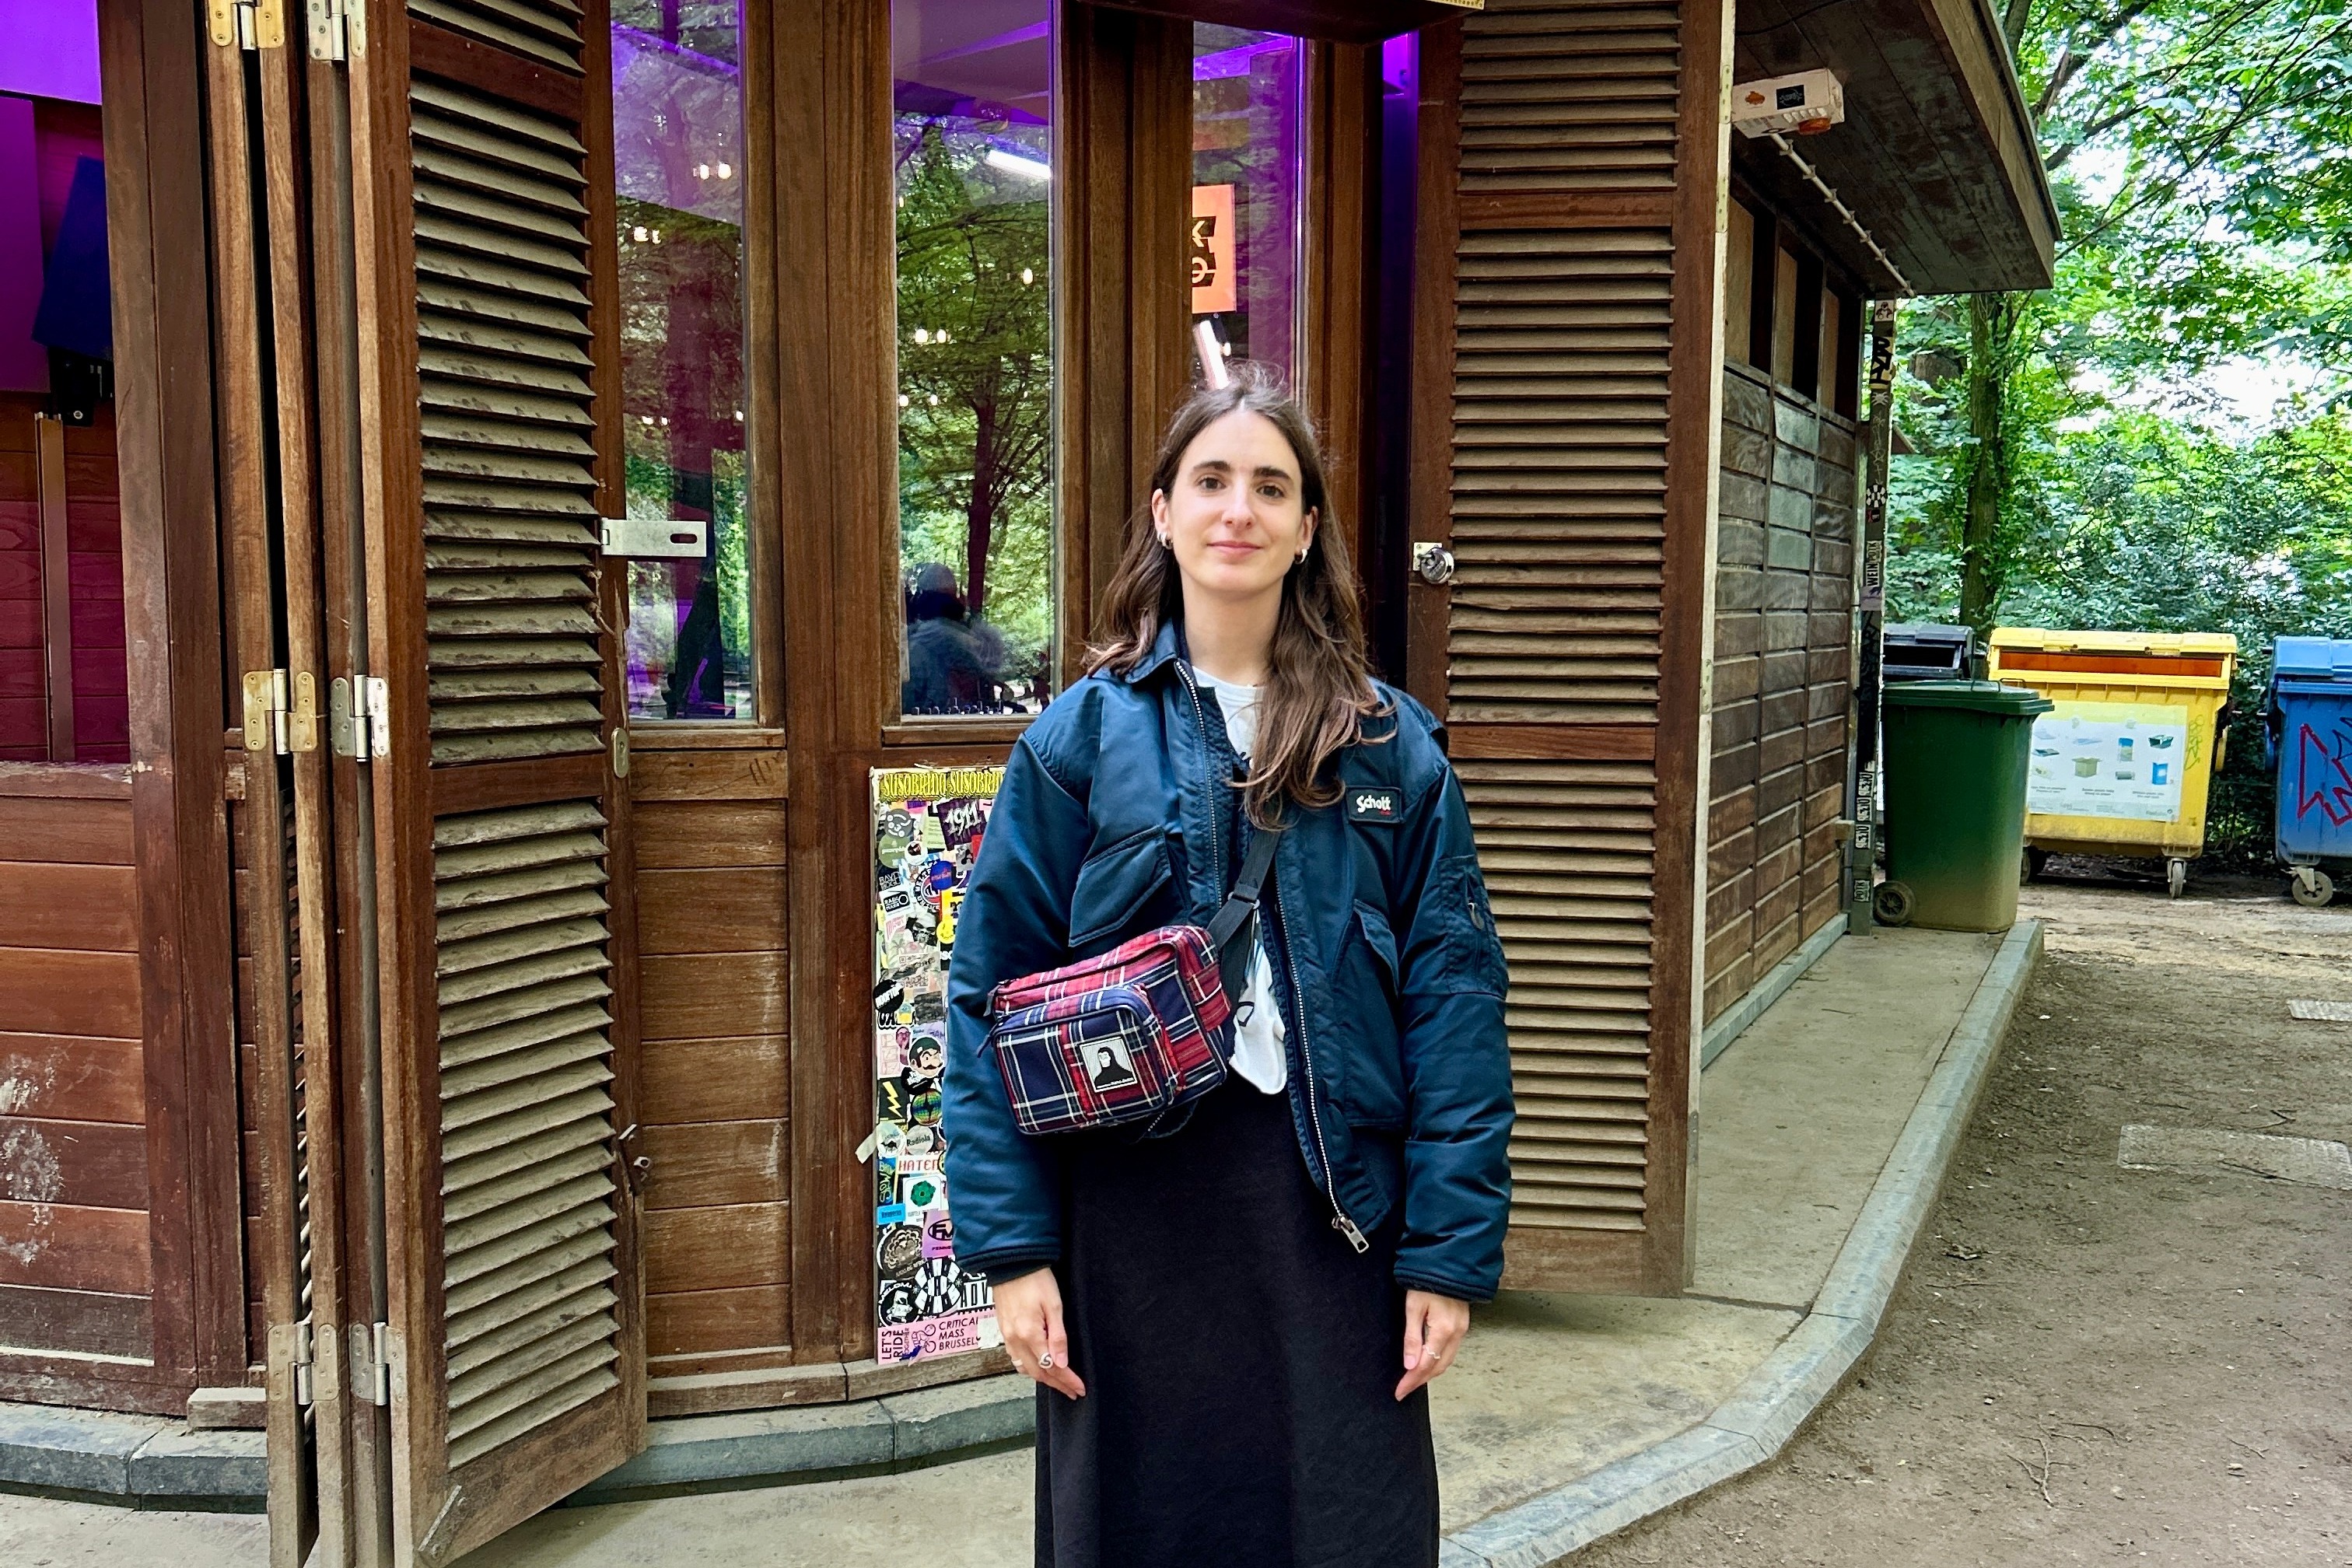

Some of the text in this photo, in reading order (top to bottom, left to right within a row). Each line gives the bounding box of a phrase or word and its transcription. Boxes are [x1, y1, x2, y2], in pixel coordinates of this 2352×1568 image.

[1356, 794, 1391, 813] Schott
[939, 1328, 964, 1340] MASS
[939, 1336, 978, 1351] BRUSSEL
[882, 1330, 892, 1360] LET'S
[893, 1330, 903, 1358] RIDE
